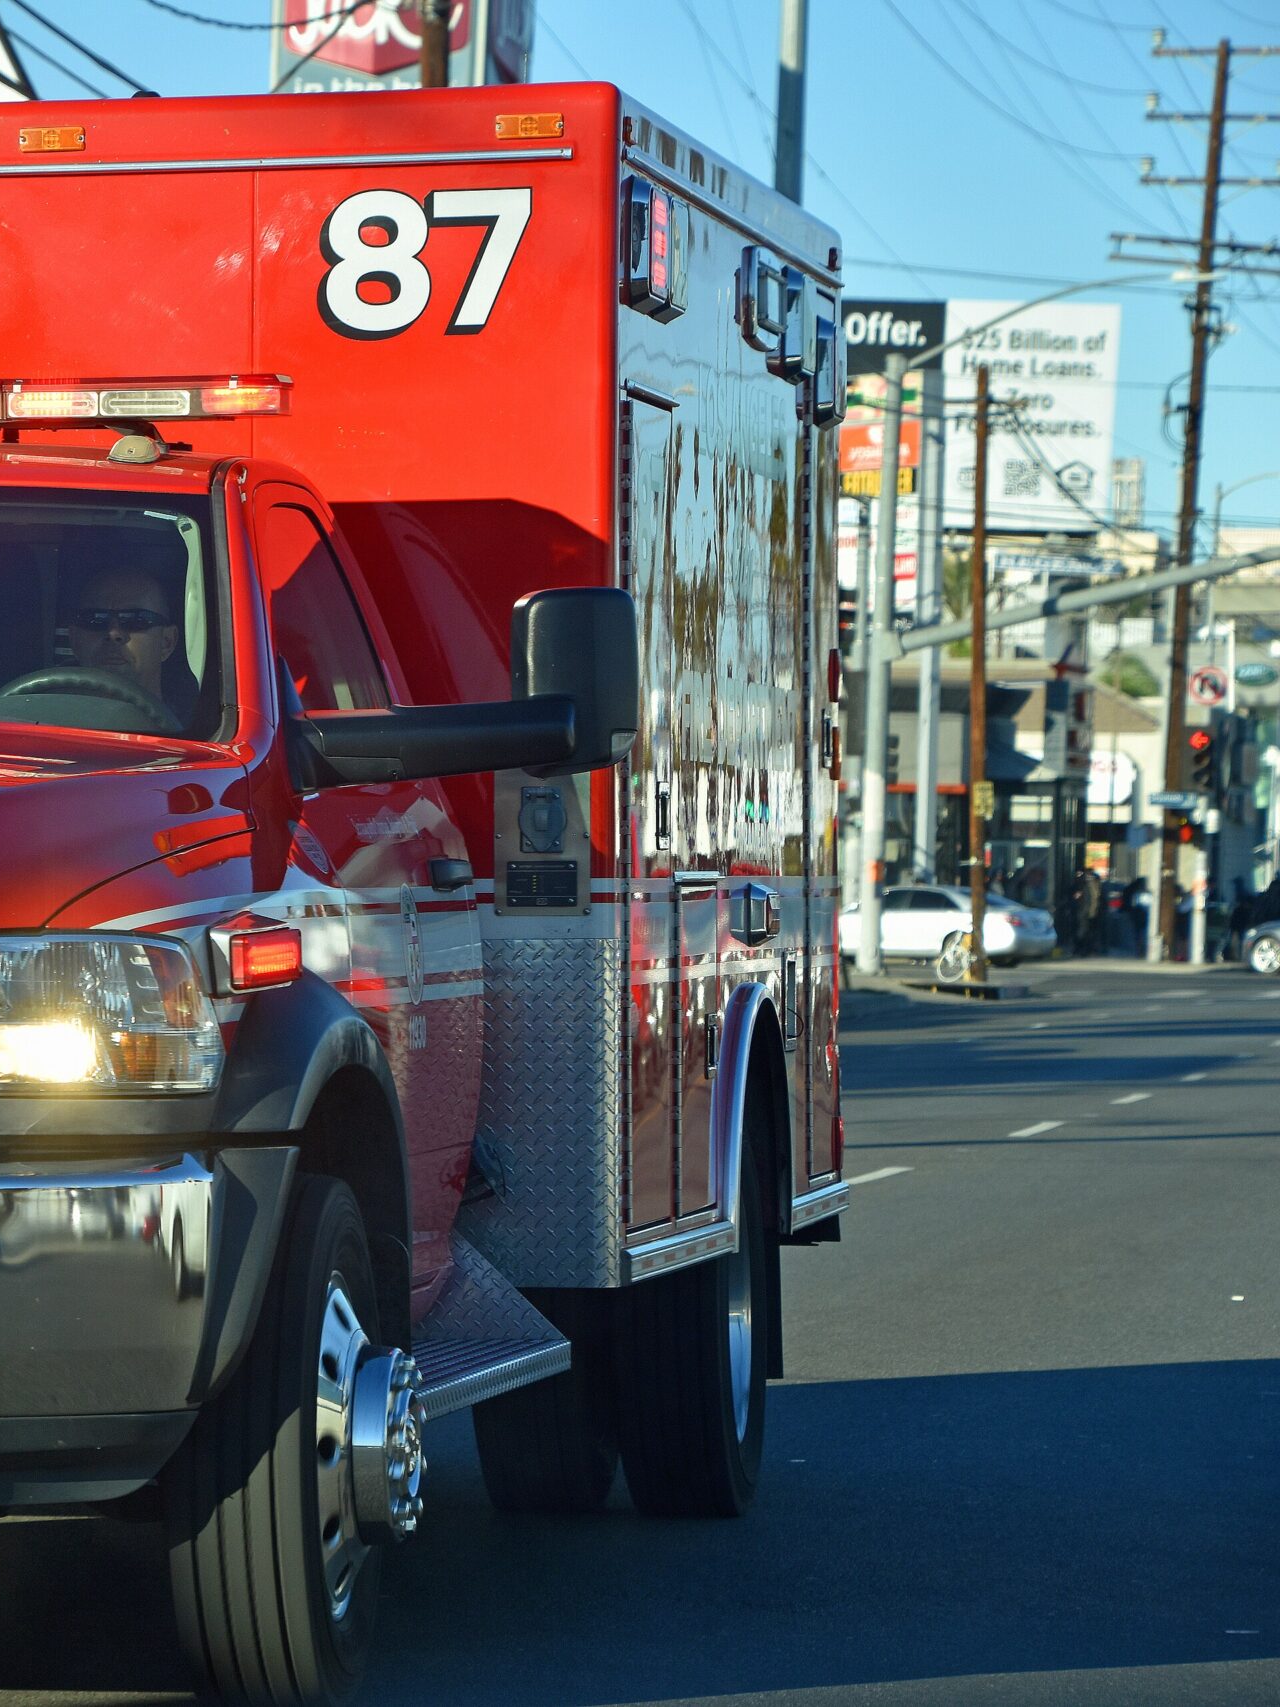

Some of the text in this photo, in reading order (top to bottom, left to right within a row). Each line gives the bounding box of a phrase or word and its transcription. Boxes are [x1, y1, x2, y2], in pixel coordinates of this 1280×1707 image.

[317, 183, 532, 341] 87
[844, 311, 927, 346] Offer.
[1009, 328, 1077, 350] Billion
[1083, 329, 1109, 351] of
[962, 355, 1102, 378] Home Loans.
[1007, 388, 1055, 411] Zero
